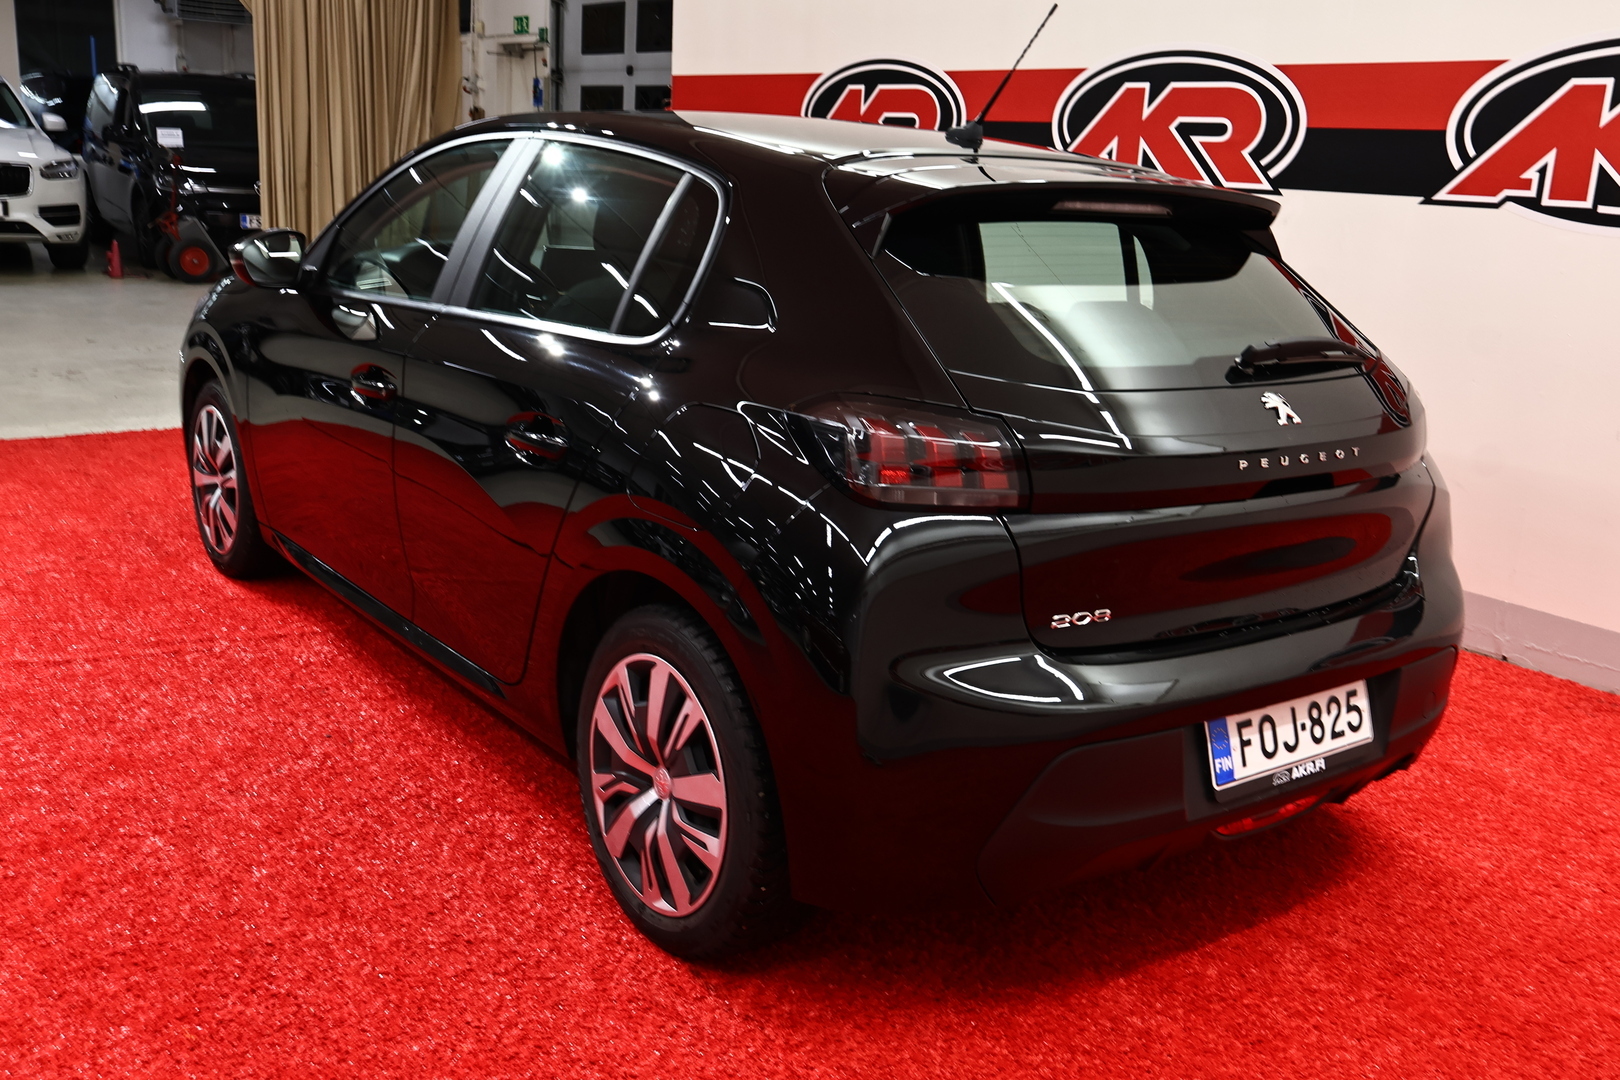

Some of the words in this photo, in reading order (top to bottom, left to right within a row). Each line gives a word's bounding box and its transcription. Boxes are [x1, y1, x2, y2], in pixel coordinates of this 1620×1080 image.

[1238, 446, 1360, 470] PEUGEOT
[1050, 608, 1111, 629] 208
[1214, 755, 1234, 774] FIN
